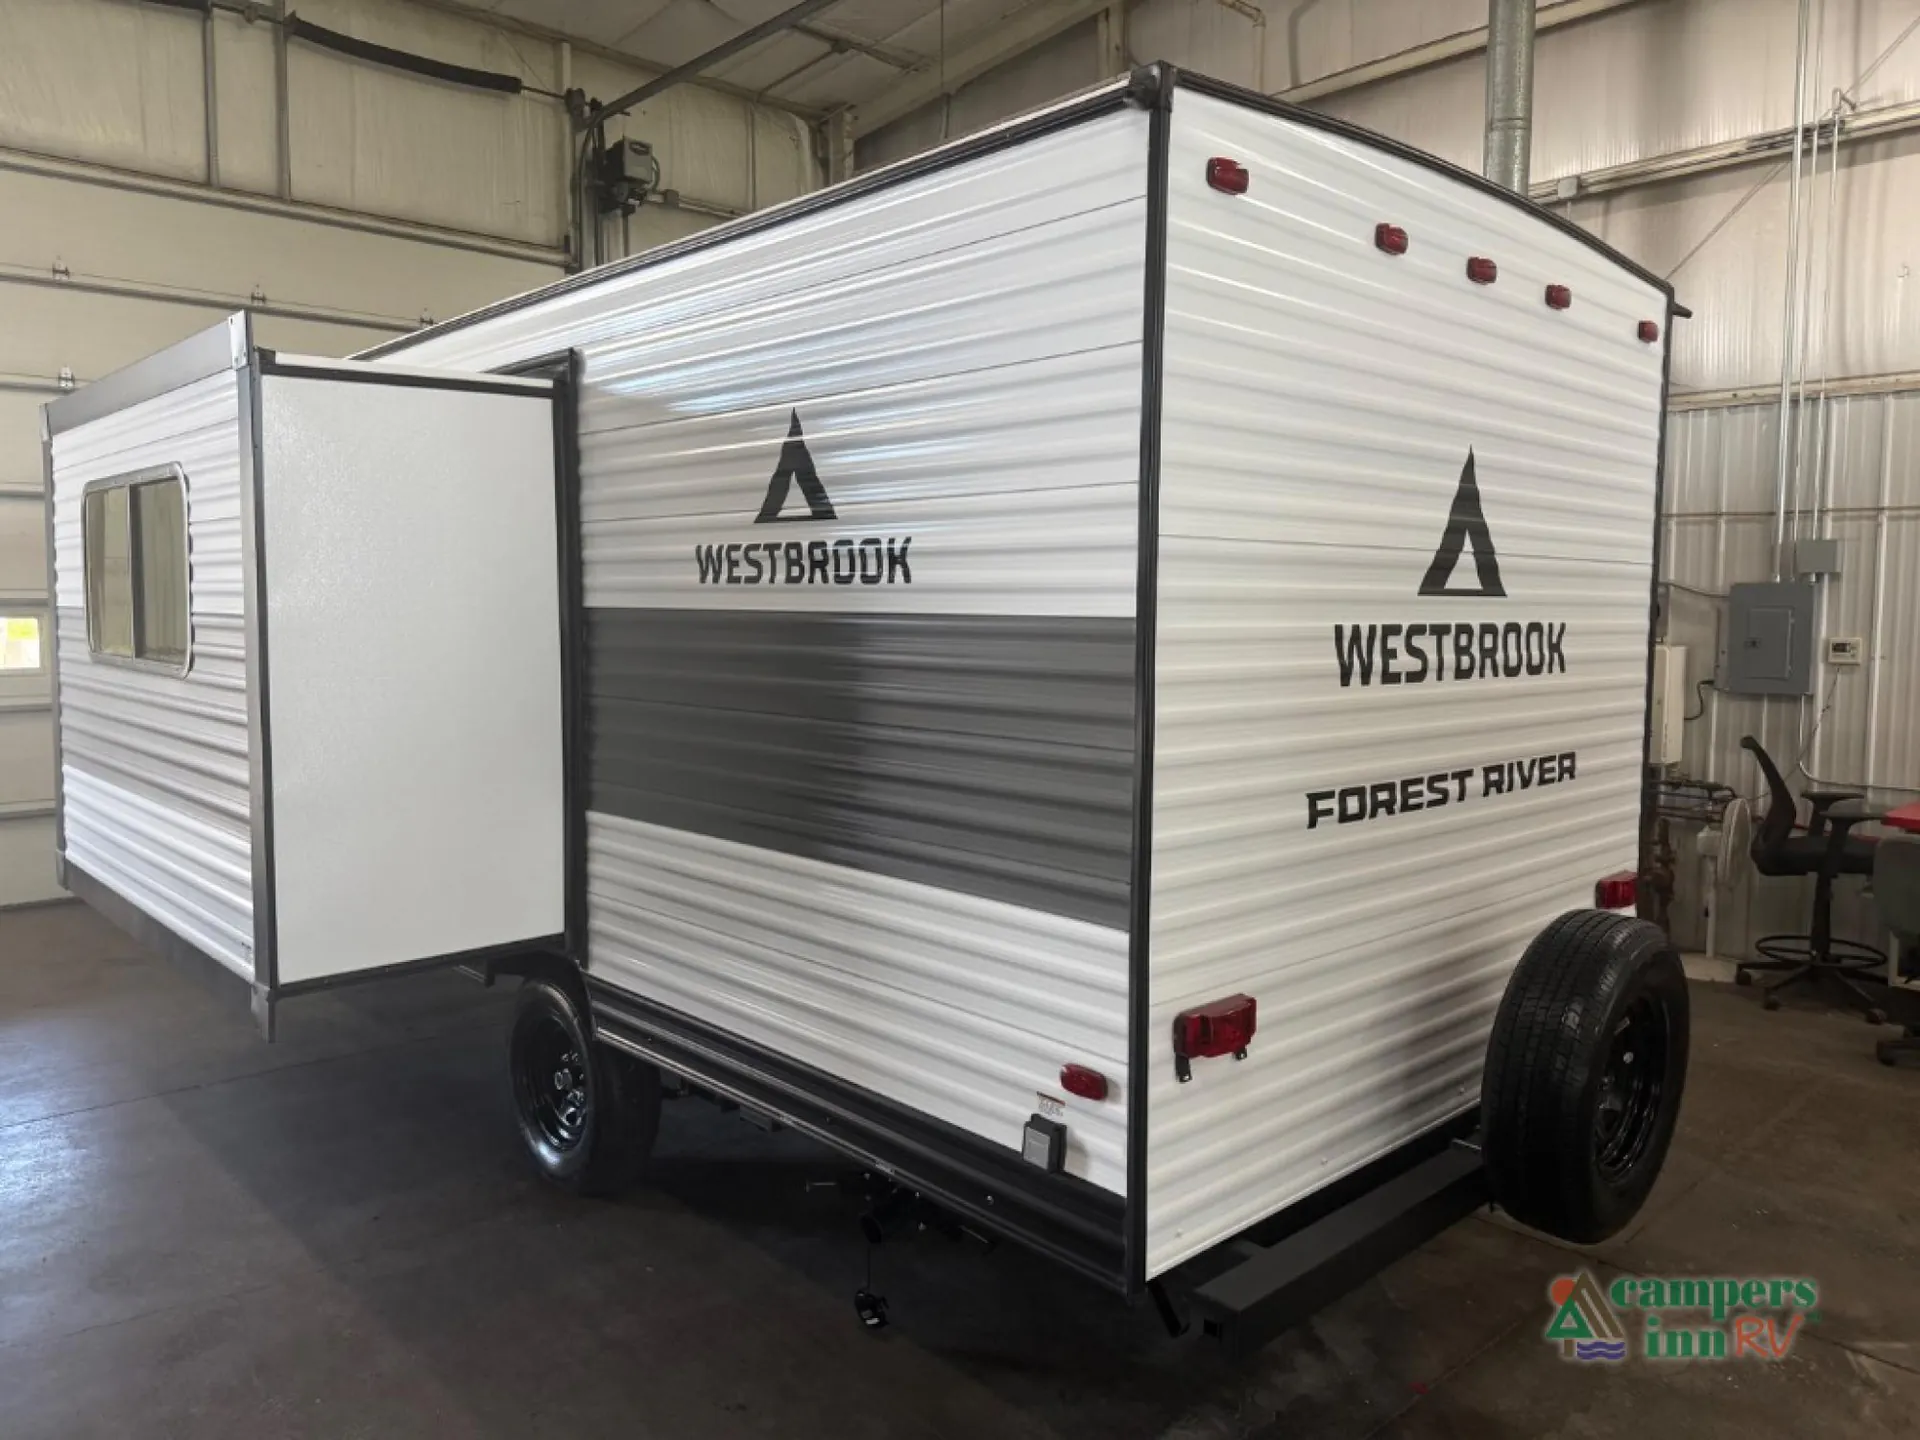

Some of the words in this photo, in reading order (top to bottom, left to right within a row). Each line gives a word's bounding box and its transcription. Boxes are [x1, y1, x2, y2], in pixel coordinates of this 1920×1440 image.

[695, 536, 912, 585] WESTBROOK
[1334, 622, 1567, 687] WESTBROOK
[1305, 768, 1474, 829] FOREST
[1482, 751, 1576, 797] RIVER
